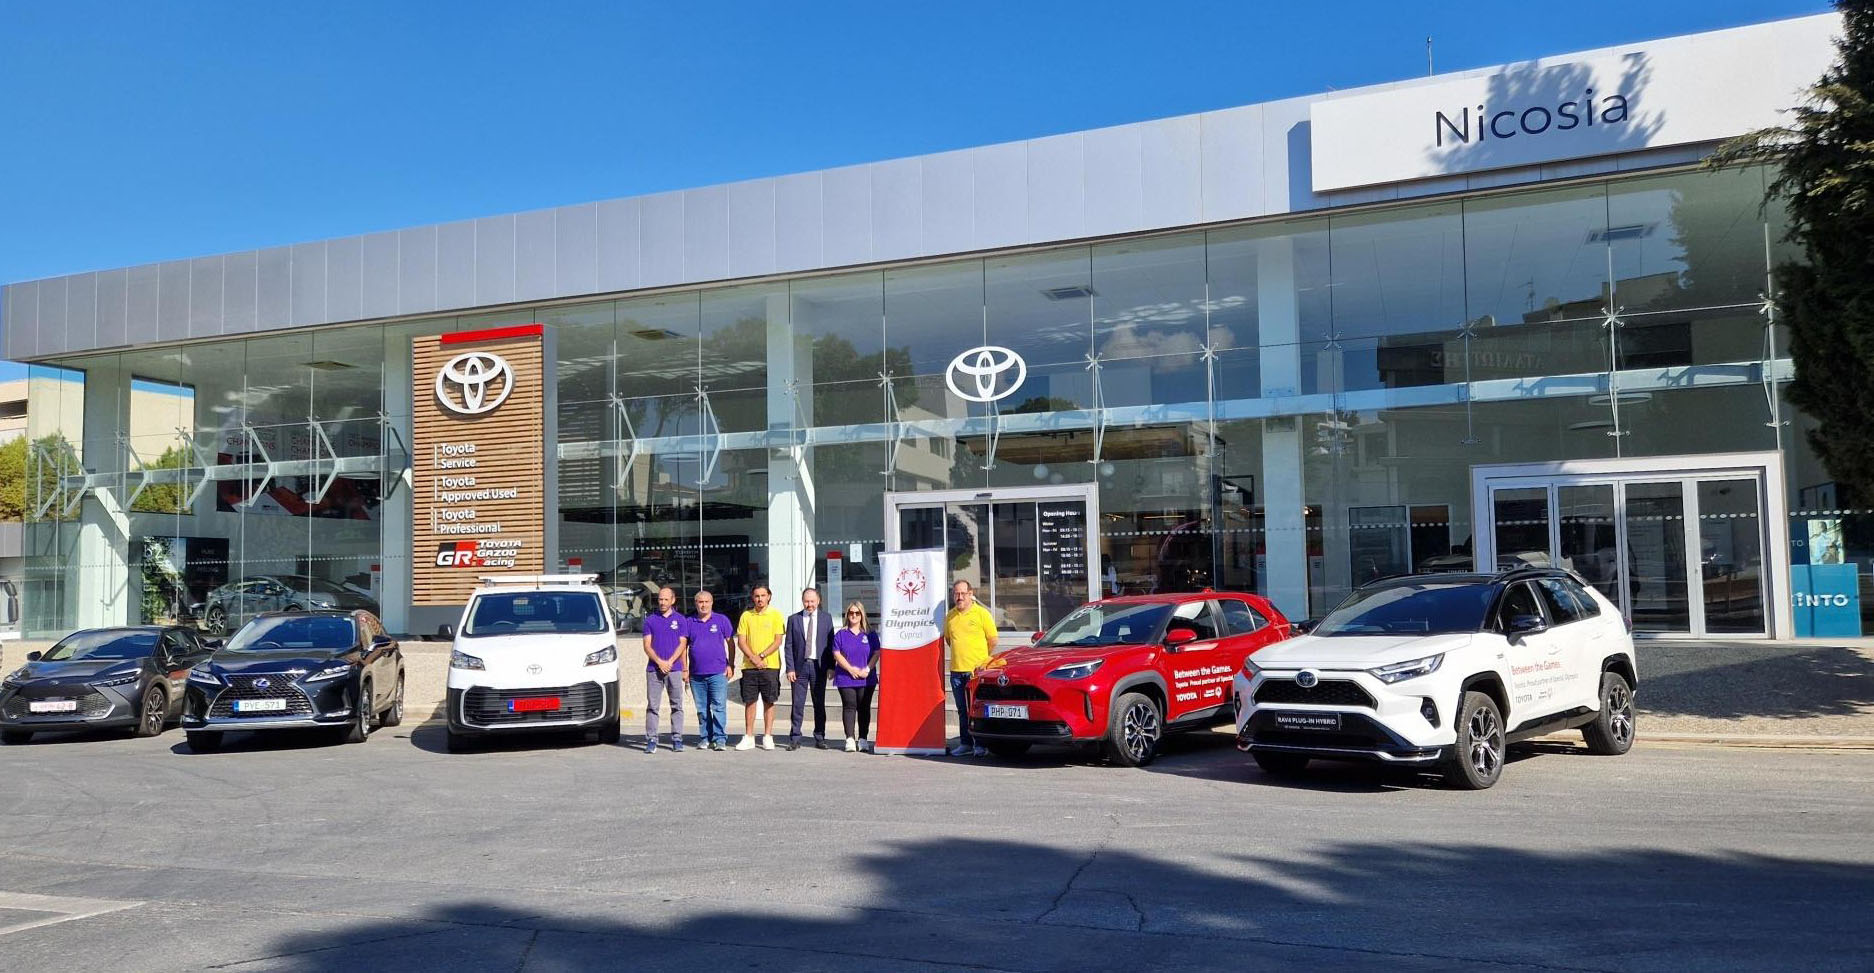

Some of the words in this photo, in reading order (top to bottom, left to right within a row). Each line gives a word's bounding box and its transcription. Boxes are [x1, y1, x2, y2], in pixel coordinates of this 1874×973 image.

[1435, 88, 1628, 147] Nicosia
[441, 443, 476, 456] Toyota
[441, 458, 476, 469] Service
[441, 476, 476, 489] Toyota
[441, 489, 490, 502] Approved
[491, 487, 517, 499] Used
[441, 509, 476, 522] Toyota
[440, 521, 501, 534] Professional
[479, 540, 522, 548] TOYOTA
[436, 550, 474, 566] GR
[477, 549, 518, 558] GAZOO
[890, 607, 930, 617] Special
[885, 619, 935, 629] Olympics
[900, 630, 923, 640] Cyprus
[1174, 669, 1200, 679] Between
[1200, 666, 1211, 675] the
[1511, 665, 1534, 675] Between
[1535, 661, 1543, 672] the
[1202, 678, 1215, 686] partner
[1176, 692, 1198, 702] TOYOTA
[1515, 694, 1533, 704] TOYOTA
